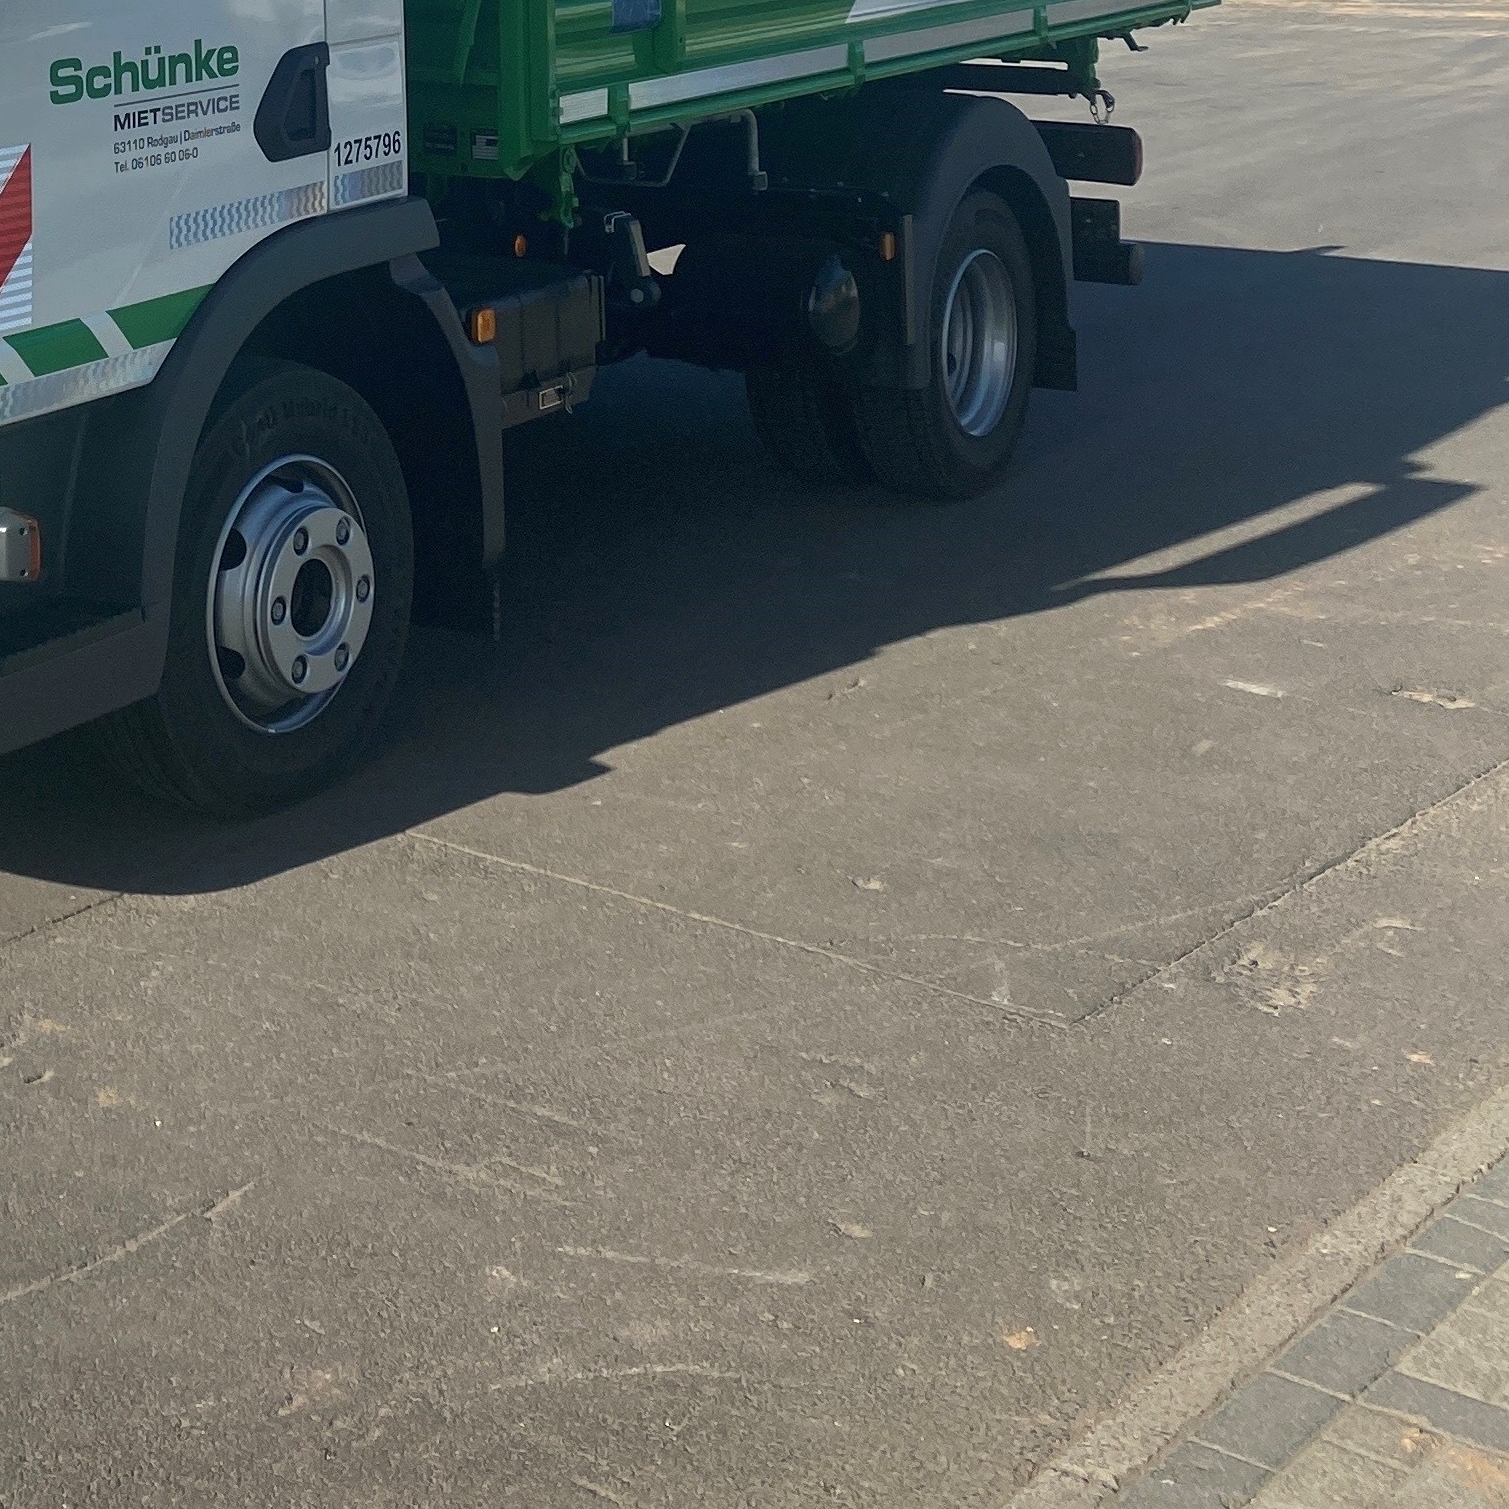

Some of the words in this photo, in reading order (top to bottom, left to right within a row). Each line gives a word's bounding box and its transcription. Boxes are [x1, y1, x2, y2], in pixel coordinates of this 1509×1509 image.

[49, 39, 240, 105] Schünke
[113, 94, 240, 132] MIETSERVICE
[113, 137, 145, 154] 63110
[147, 134, 178, 148] Rodgau
[114, 160, 129, 173] Tel.
[131, 154, 162, 170] 06106
[164, 151, 176, 164] 60
[334, 130, 401, 167] 1275796
